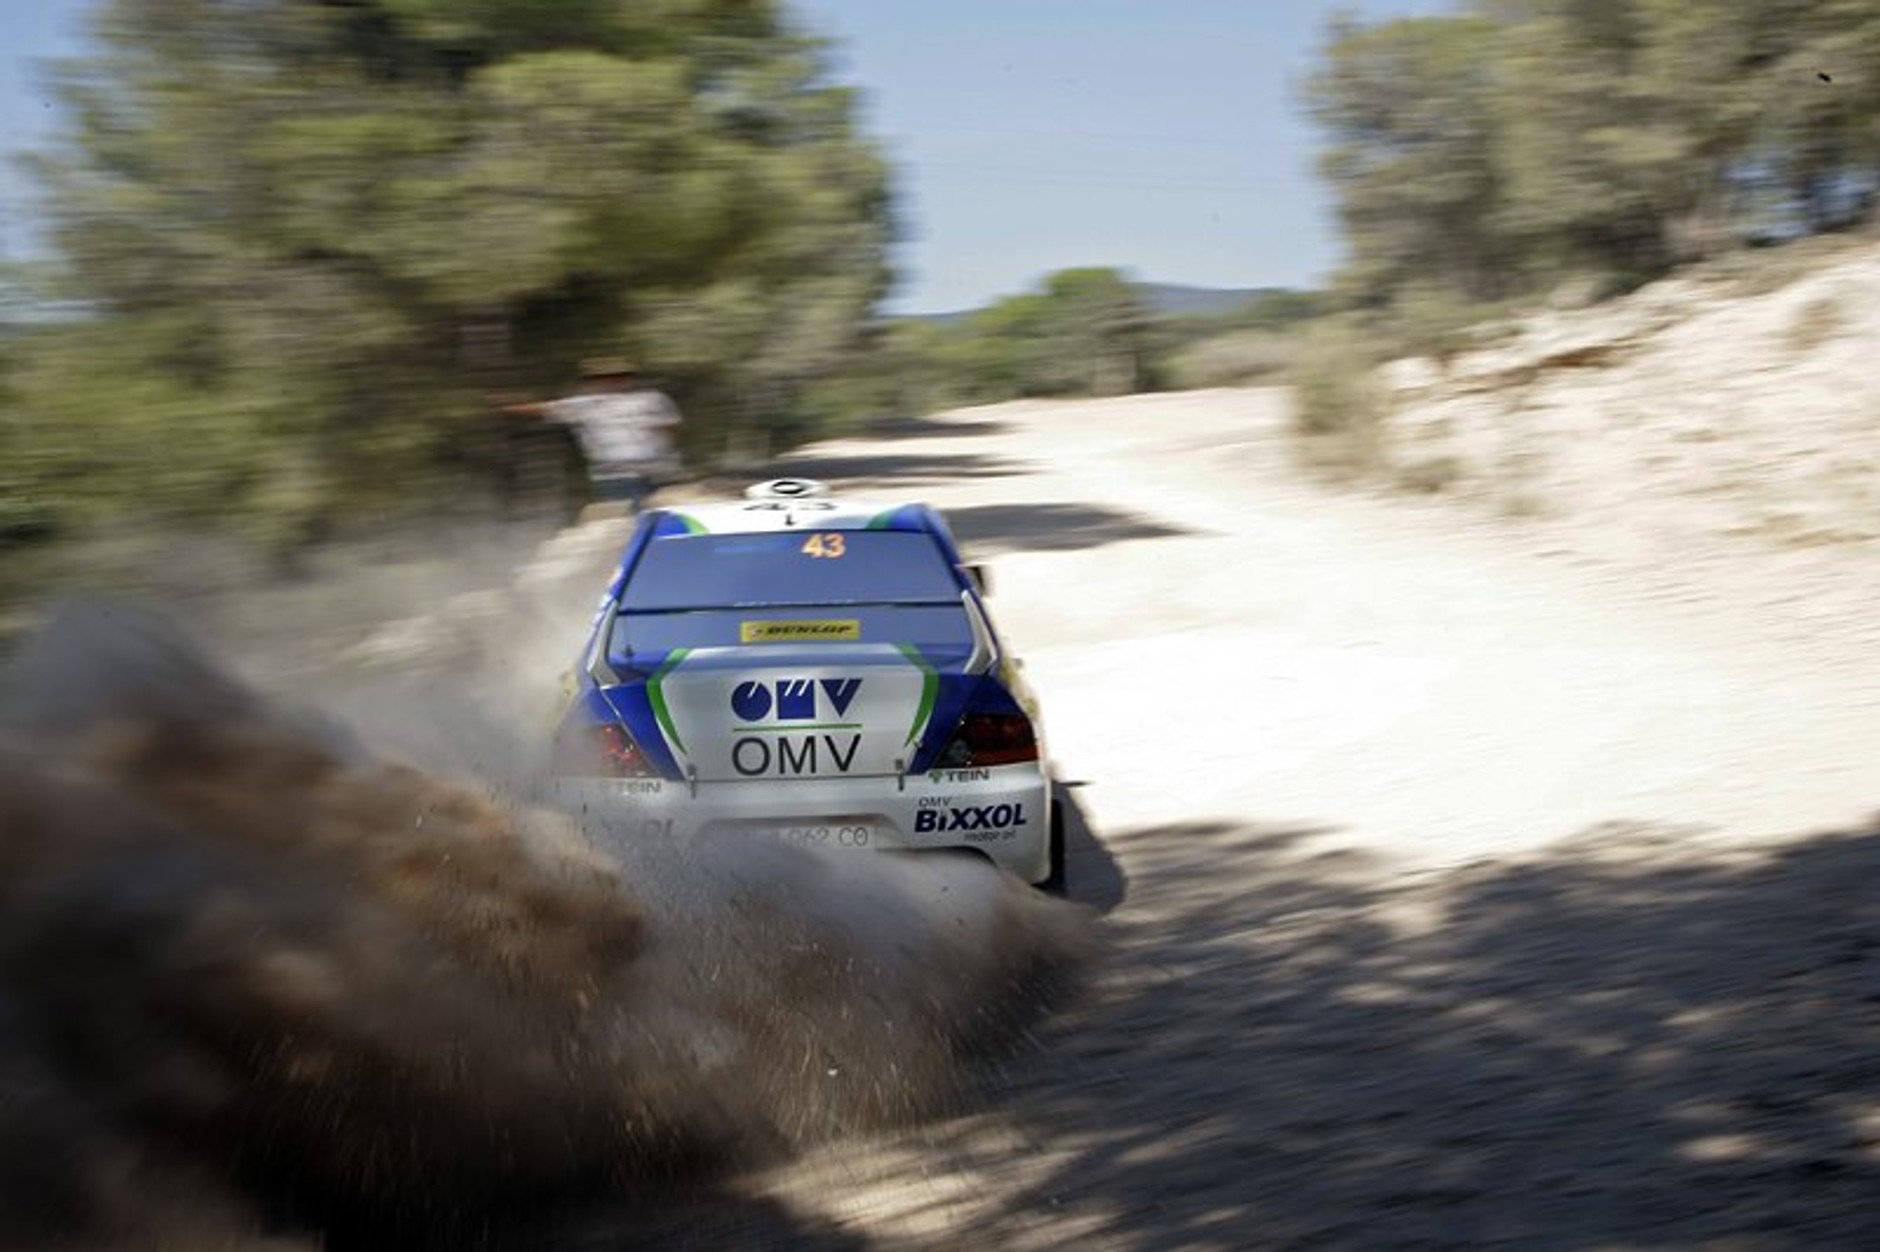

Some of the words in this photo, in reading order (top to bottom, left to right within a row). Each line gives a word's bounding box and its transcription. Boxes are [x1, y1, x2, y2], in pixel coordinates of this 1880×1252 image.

[801, 533, 847, 558] 43
[766, 624, 853, 635] DUNLOP
[732, 733, 862, 776] OMV
[945, 769, 990, 782] TEIN
[918, 797, 951, 807] OMV
